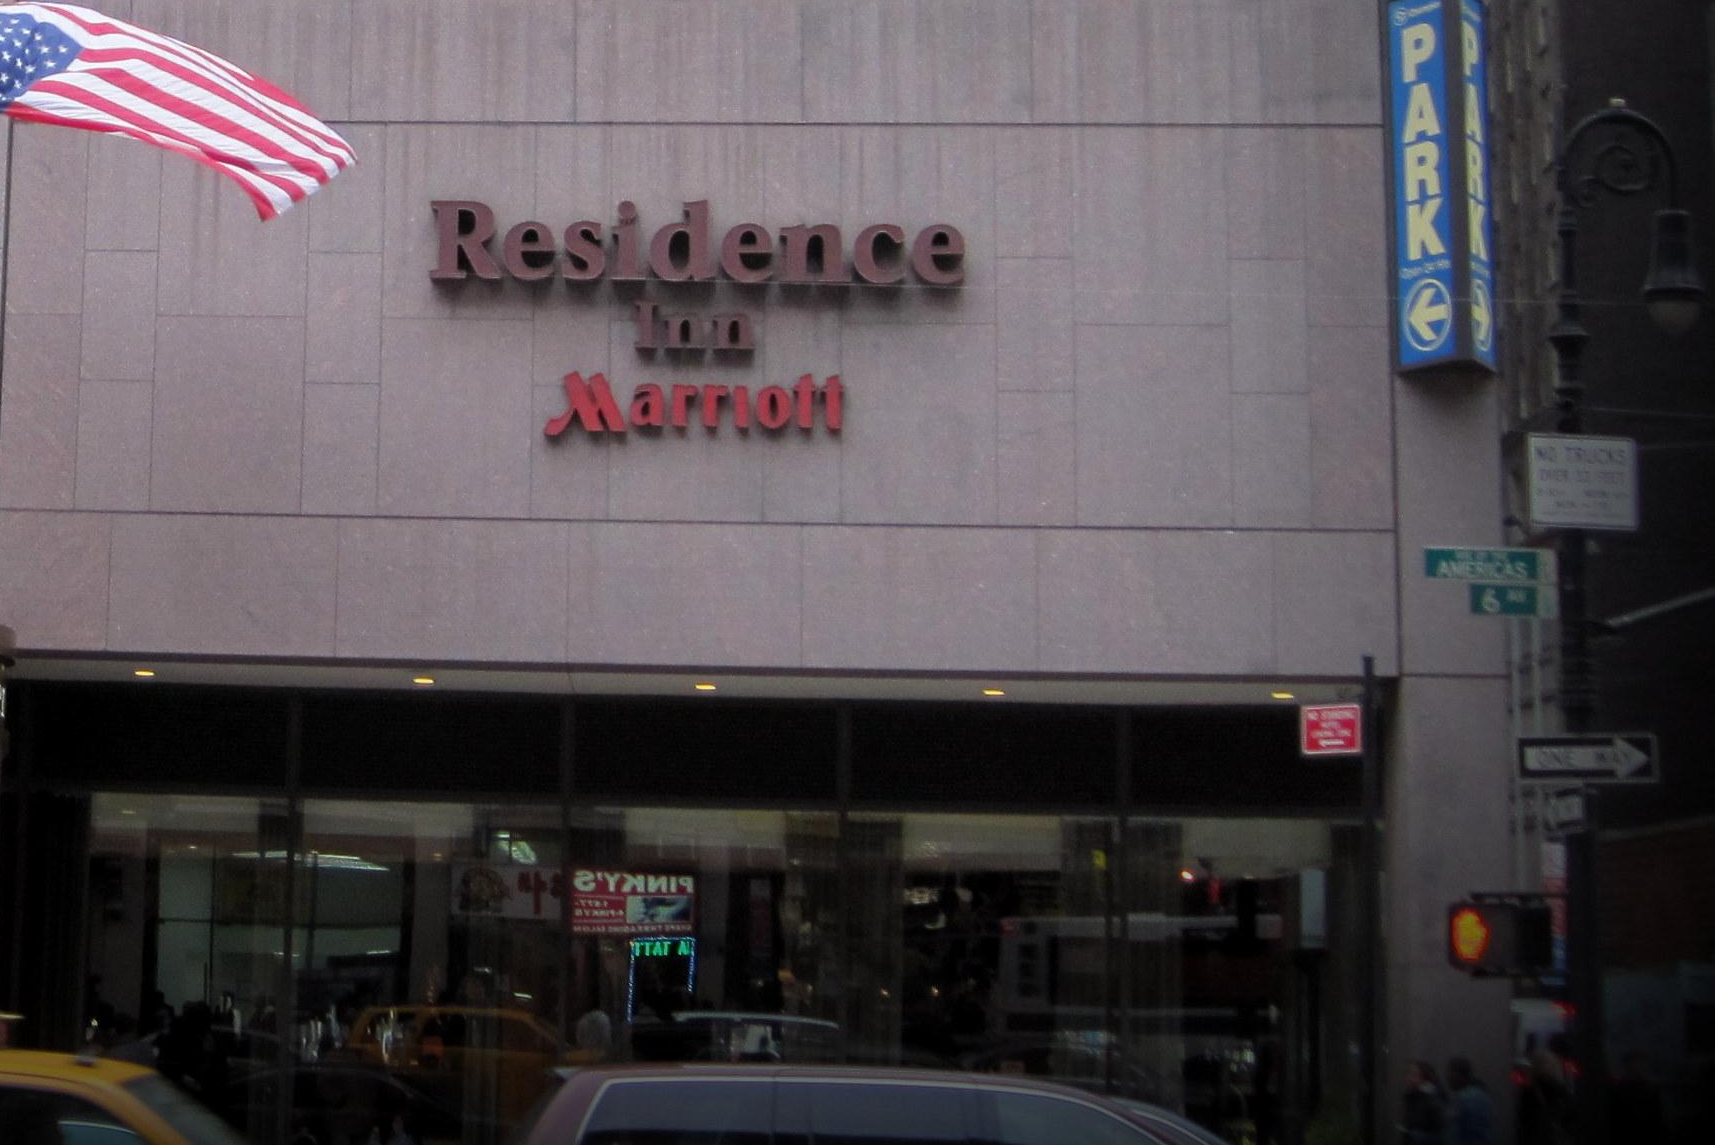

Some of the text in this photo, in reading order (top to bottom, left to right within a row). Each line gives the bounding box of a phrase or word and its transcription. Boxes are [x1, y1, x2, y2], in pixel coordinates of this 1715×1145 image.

[1402, 22, 1446, 262] PARK
[1462, 20, 1487, 263] PARK
[429, 199, 966, 285] Residence
[634, 300, 755, 351] Inn
[543, 370, 845, 436] Marriott
[1436, 559, 1529, 579] AMERICAS
[1481, 587, 1501, 614] 6
